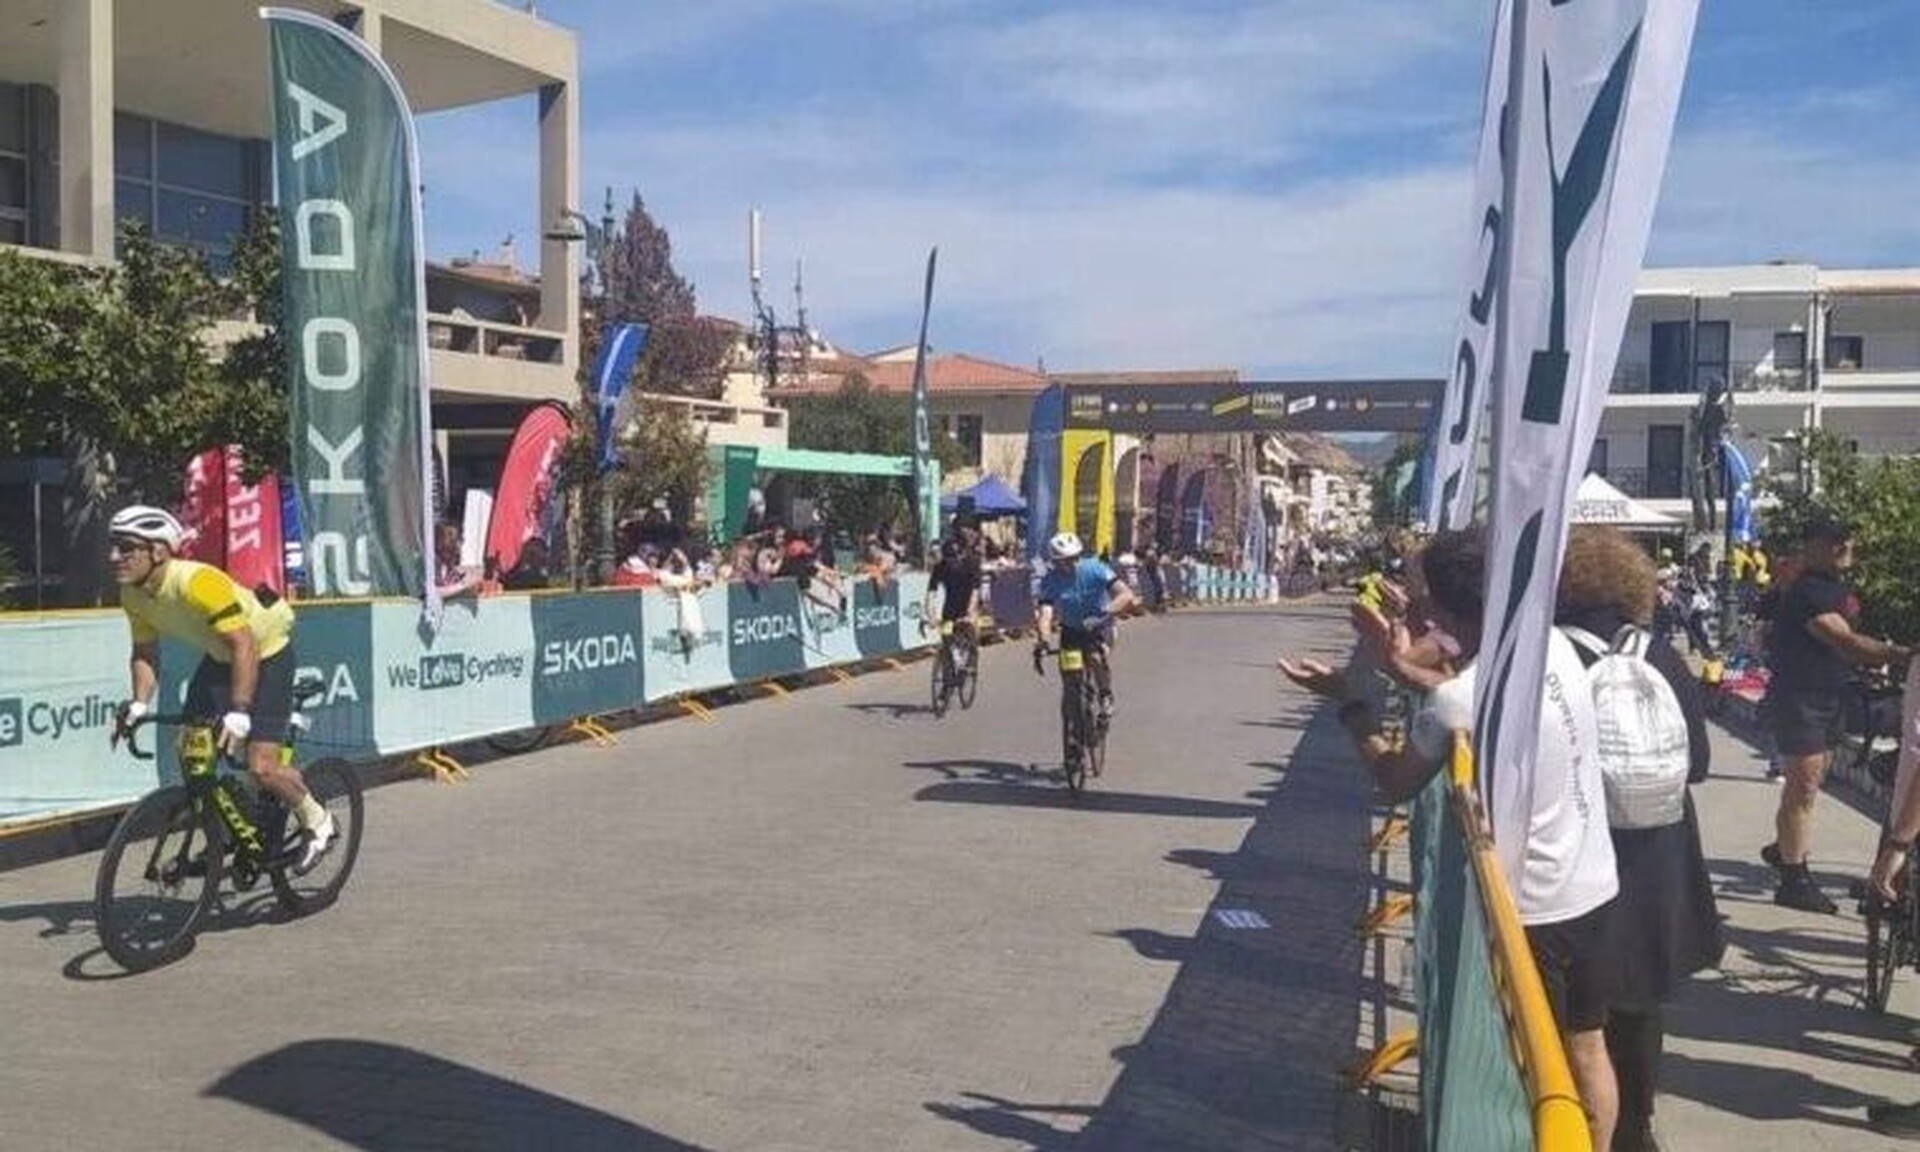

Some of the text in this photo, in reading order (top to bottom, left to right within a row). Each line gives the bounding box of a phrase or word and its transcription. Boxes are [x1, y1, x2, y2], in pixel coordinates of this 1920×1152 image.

[388, 665, 418, 688] We
[423, 657, 462, 687] Love
[466, 654, 524, 683] Cycling
[27, 694, 119, 740] Cyclin
